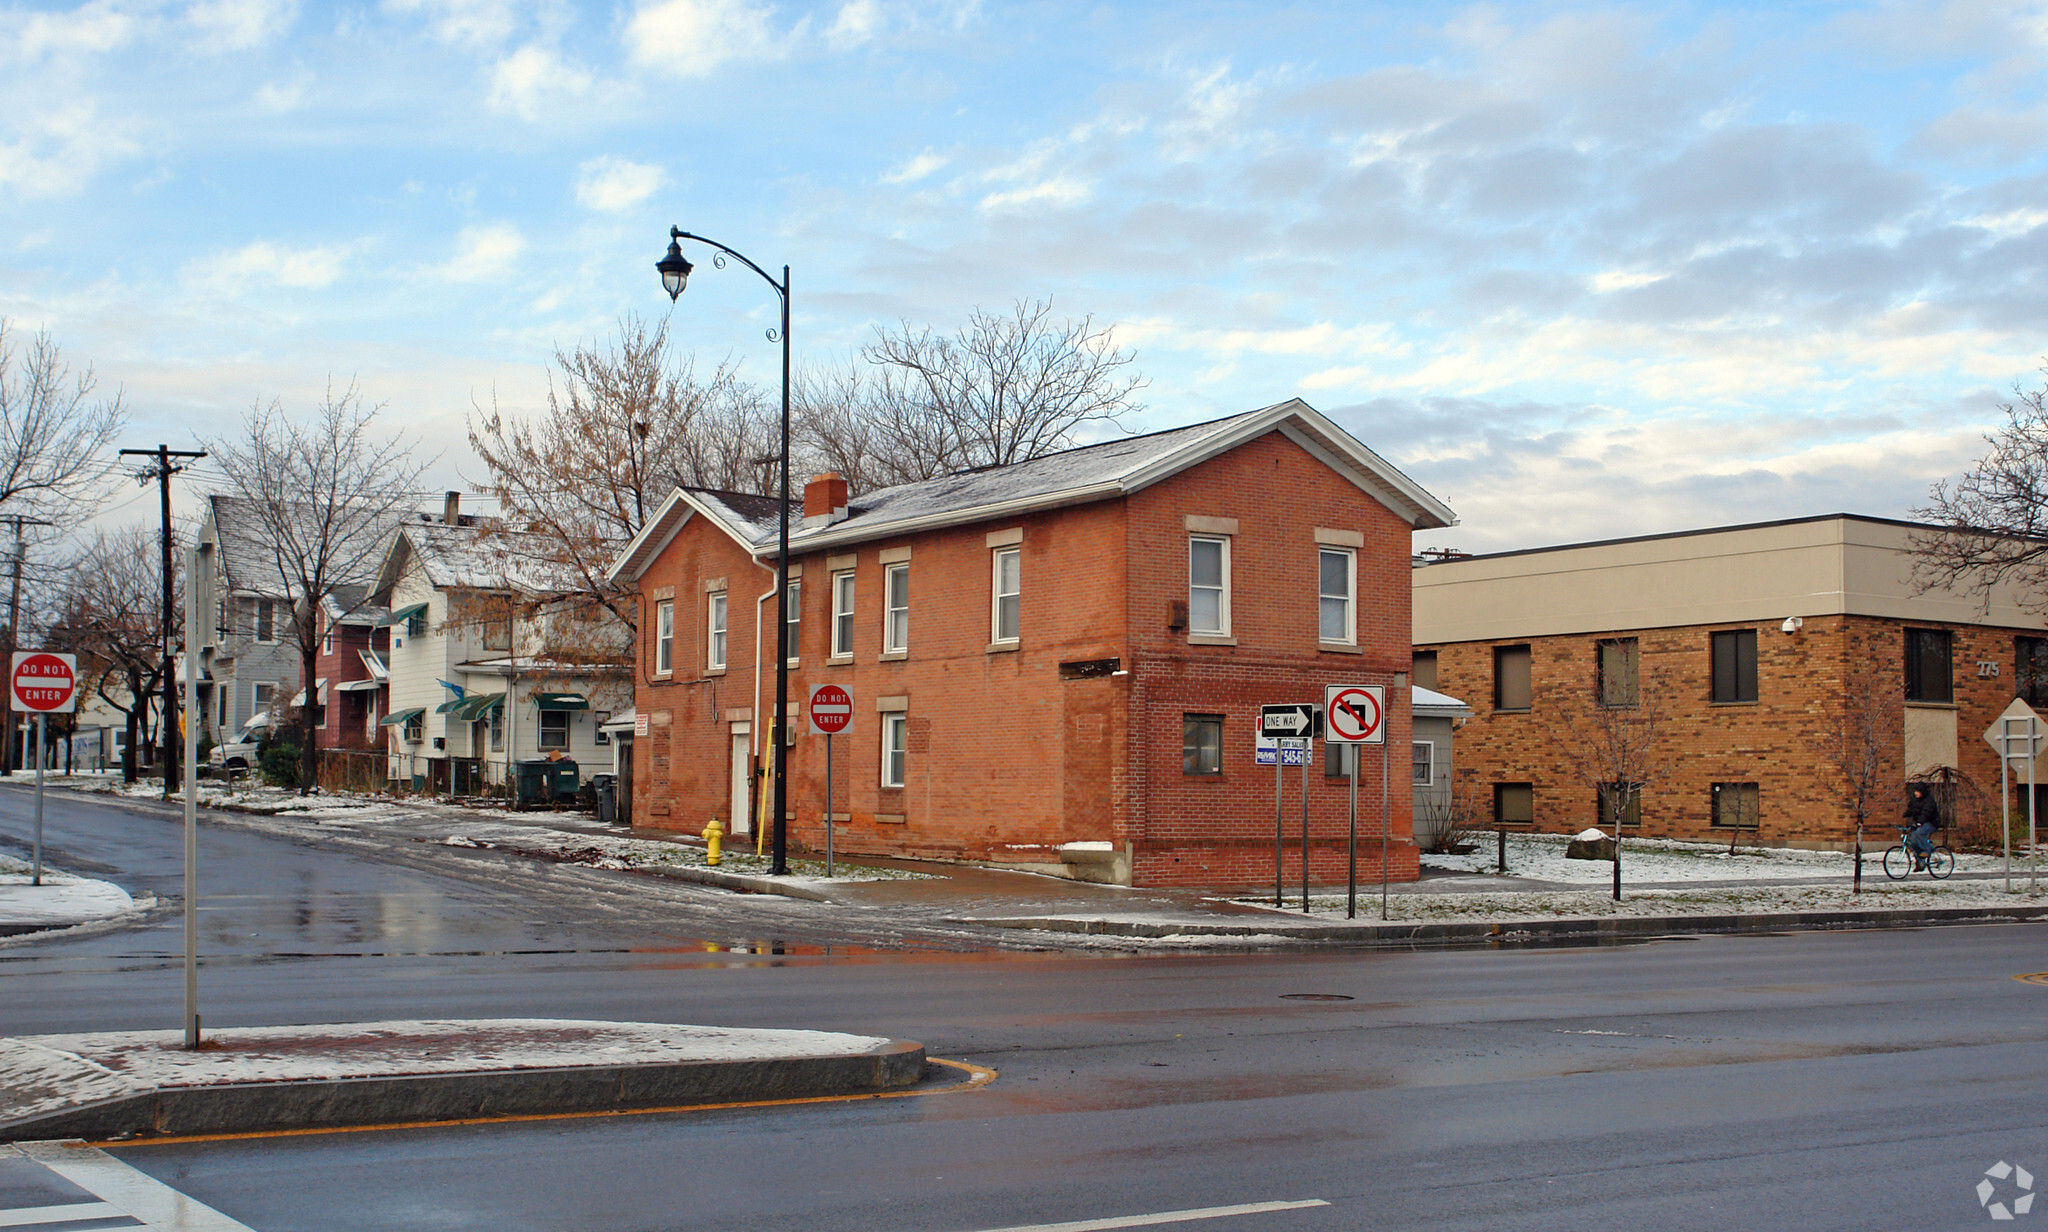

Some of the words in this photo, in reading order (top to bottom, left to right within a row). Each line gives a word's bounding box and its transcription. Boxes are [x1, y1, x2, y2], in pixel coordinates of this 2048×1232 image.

[22, 664, 37, 674] DO
[43, 665, 66, 675] NOT
[1976, 660, 1999, 677] 275
[25, 690, 61, 700] ENTER
[816, 694, 827, 702] DO
[830, 694, 846, 703] NOT
[819, 715, 844, 724] ENTER
[1265, 716, 1280, 727] ONE
[1282, 716, 1297, 726] WAY
